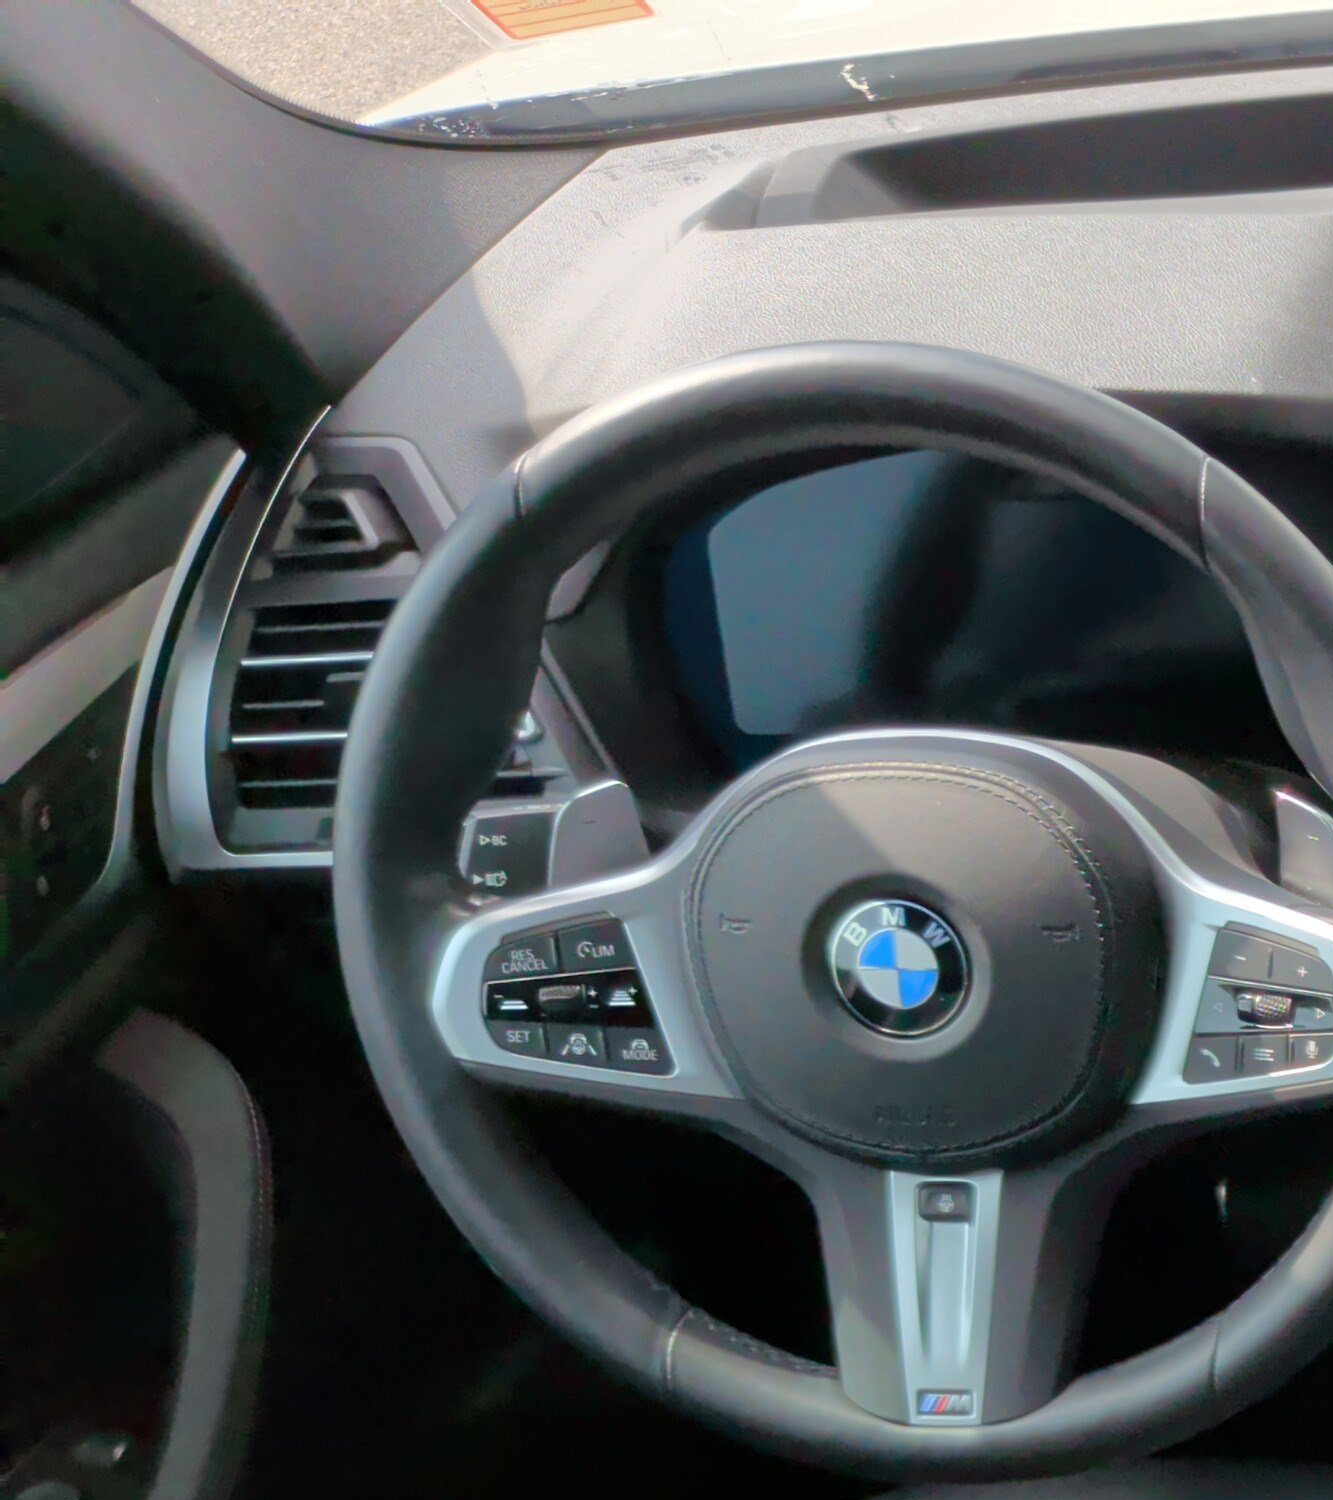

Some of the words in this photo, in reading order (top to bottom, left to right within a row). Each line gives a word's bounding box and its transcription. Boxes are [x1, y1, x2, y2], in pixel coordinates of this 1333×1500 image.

[844, 907, 951, 948] BMW
[510, 948, 535, 962] RES
[501, 957, 548, 974] CANCEL
[506, 1030, 531, 1043] SET
[622, 1048, 658, 1061] MODE
